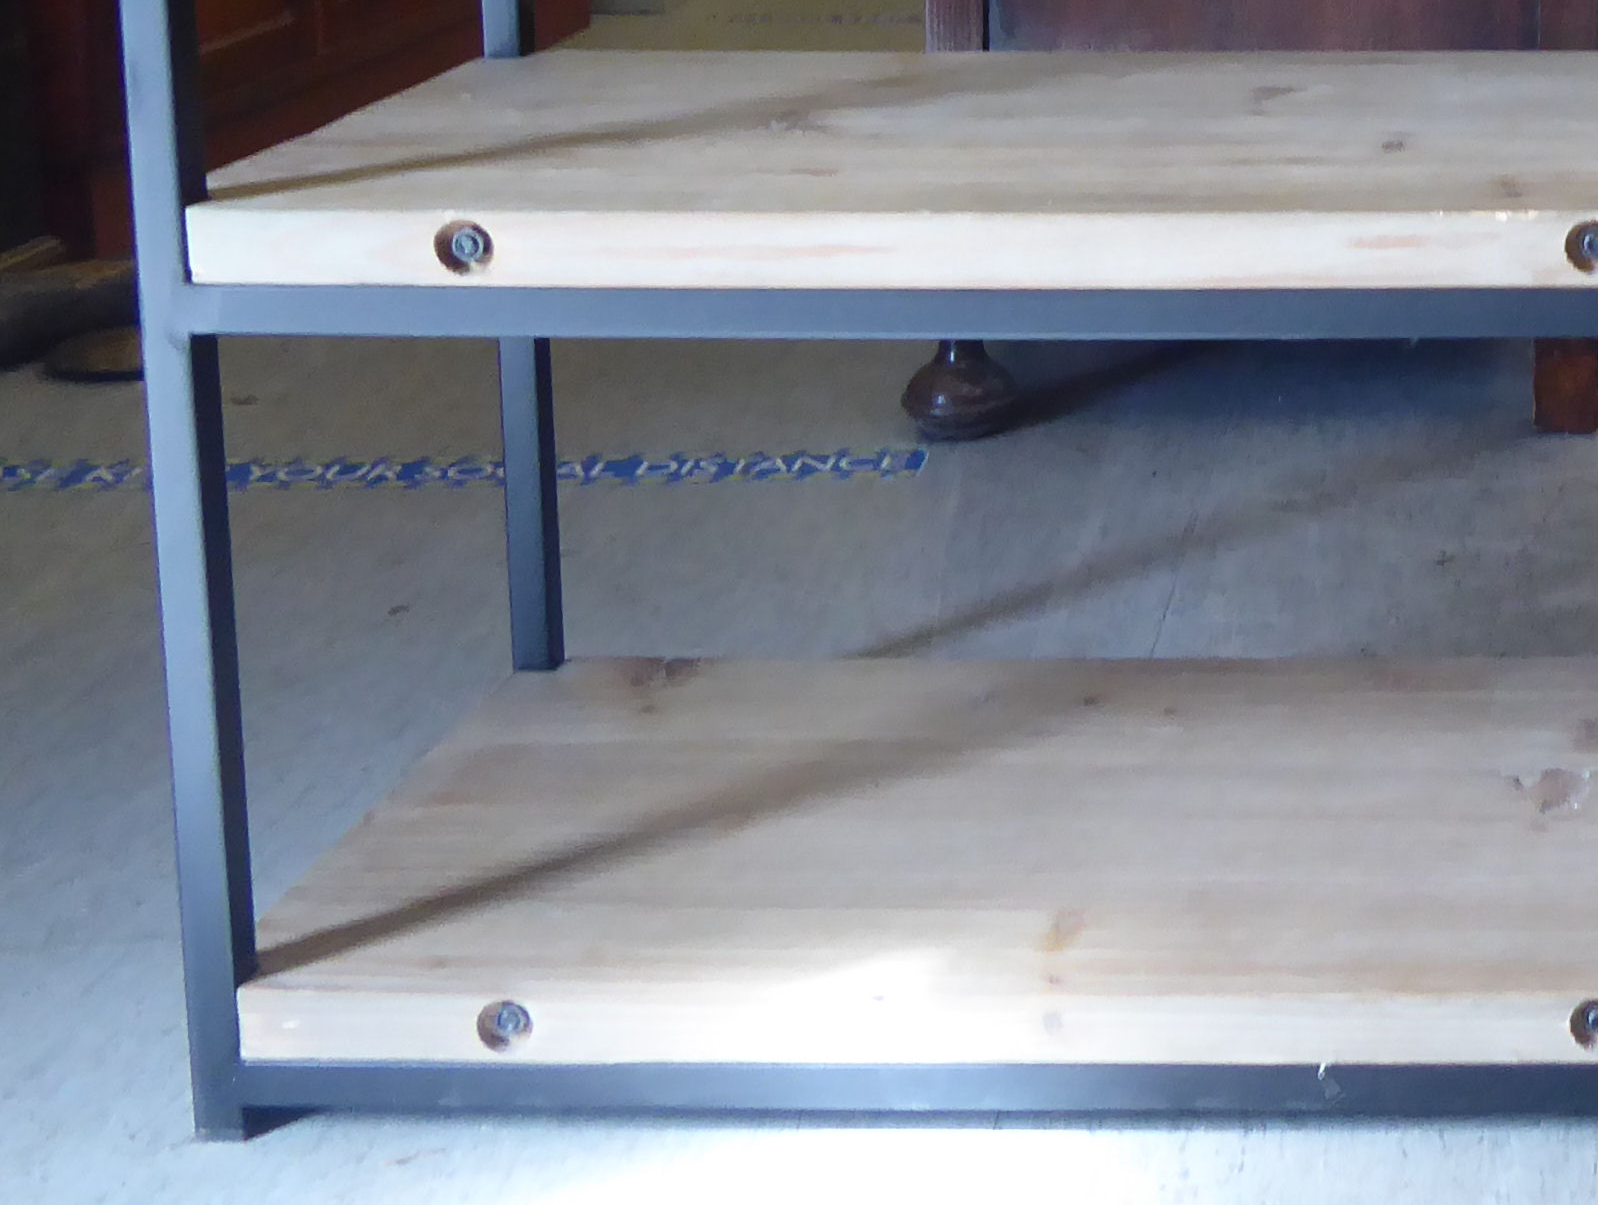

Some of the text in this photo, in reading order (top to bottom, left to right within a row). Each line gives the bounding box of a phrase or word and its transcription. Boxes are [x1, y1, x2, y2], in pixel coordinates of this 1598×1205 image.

[248, 462, 403, 483] YOUR
[412, 460, 615, 482] SOAL
[634, 452, 908, 478] DISTANCE
